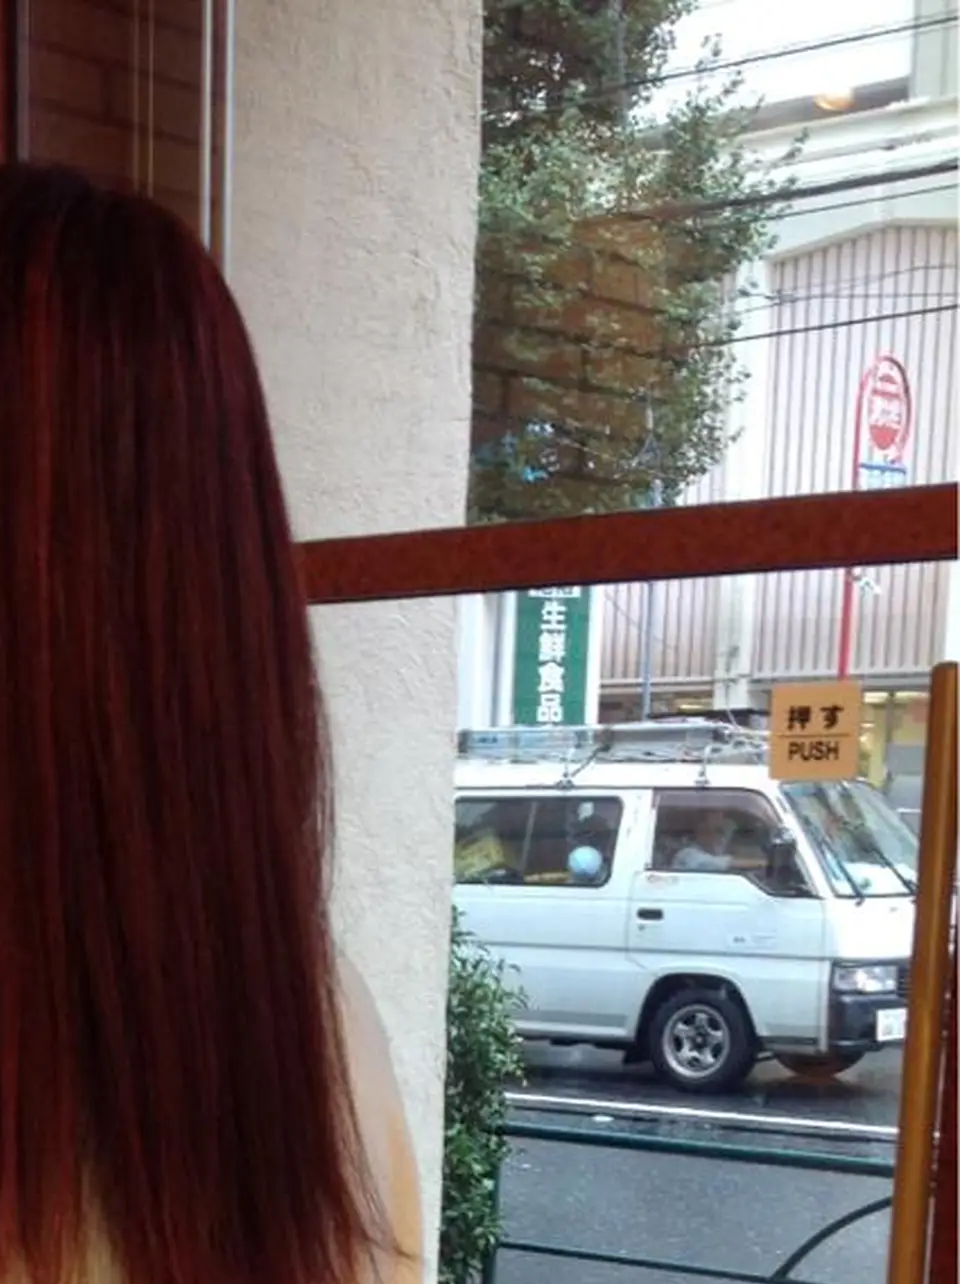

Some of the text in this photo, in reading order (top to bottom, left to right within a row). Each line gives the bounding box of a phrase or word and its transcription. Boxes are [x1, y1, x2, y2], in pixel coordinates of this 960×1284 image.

[536, 600, 568, 722] 生鮮食品
[787, 705, 844, 731] 押す
[788, 741, 839, 762] PUSH
